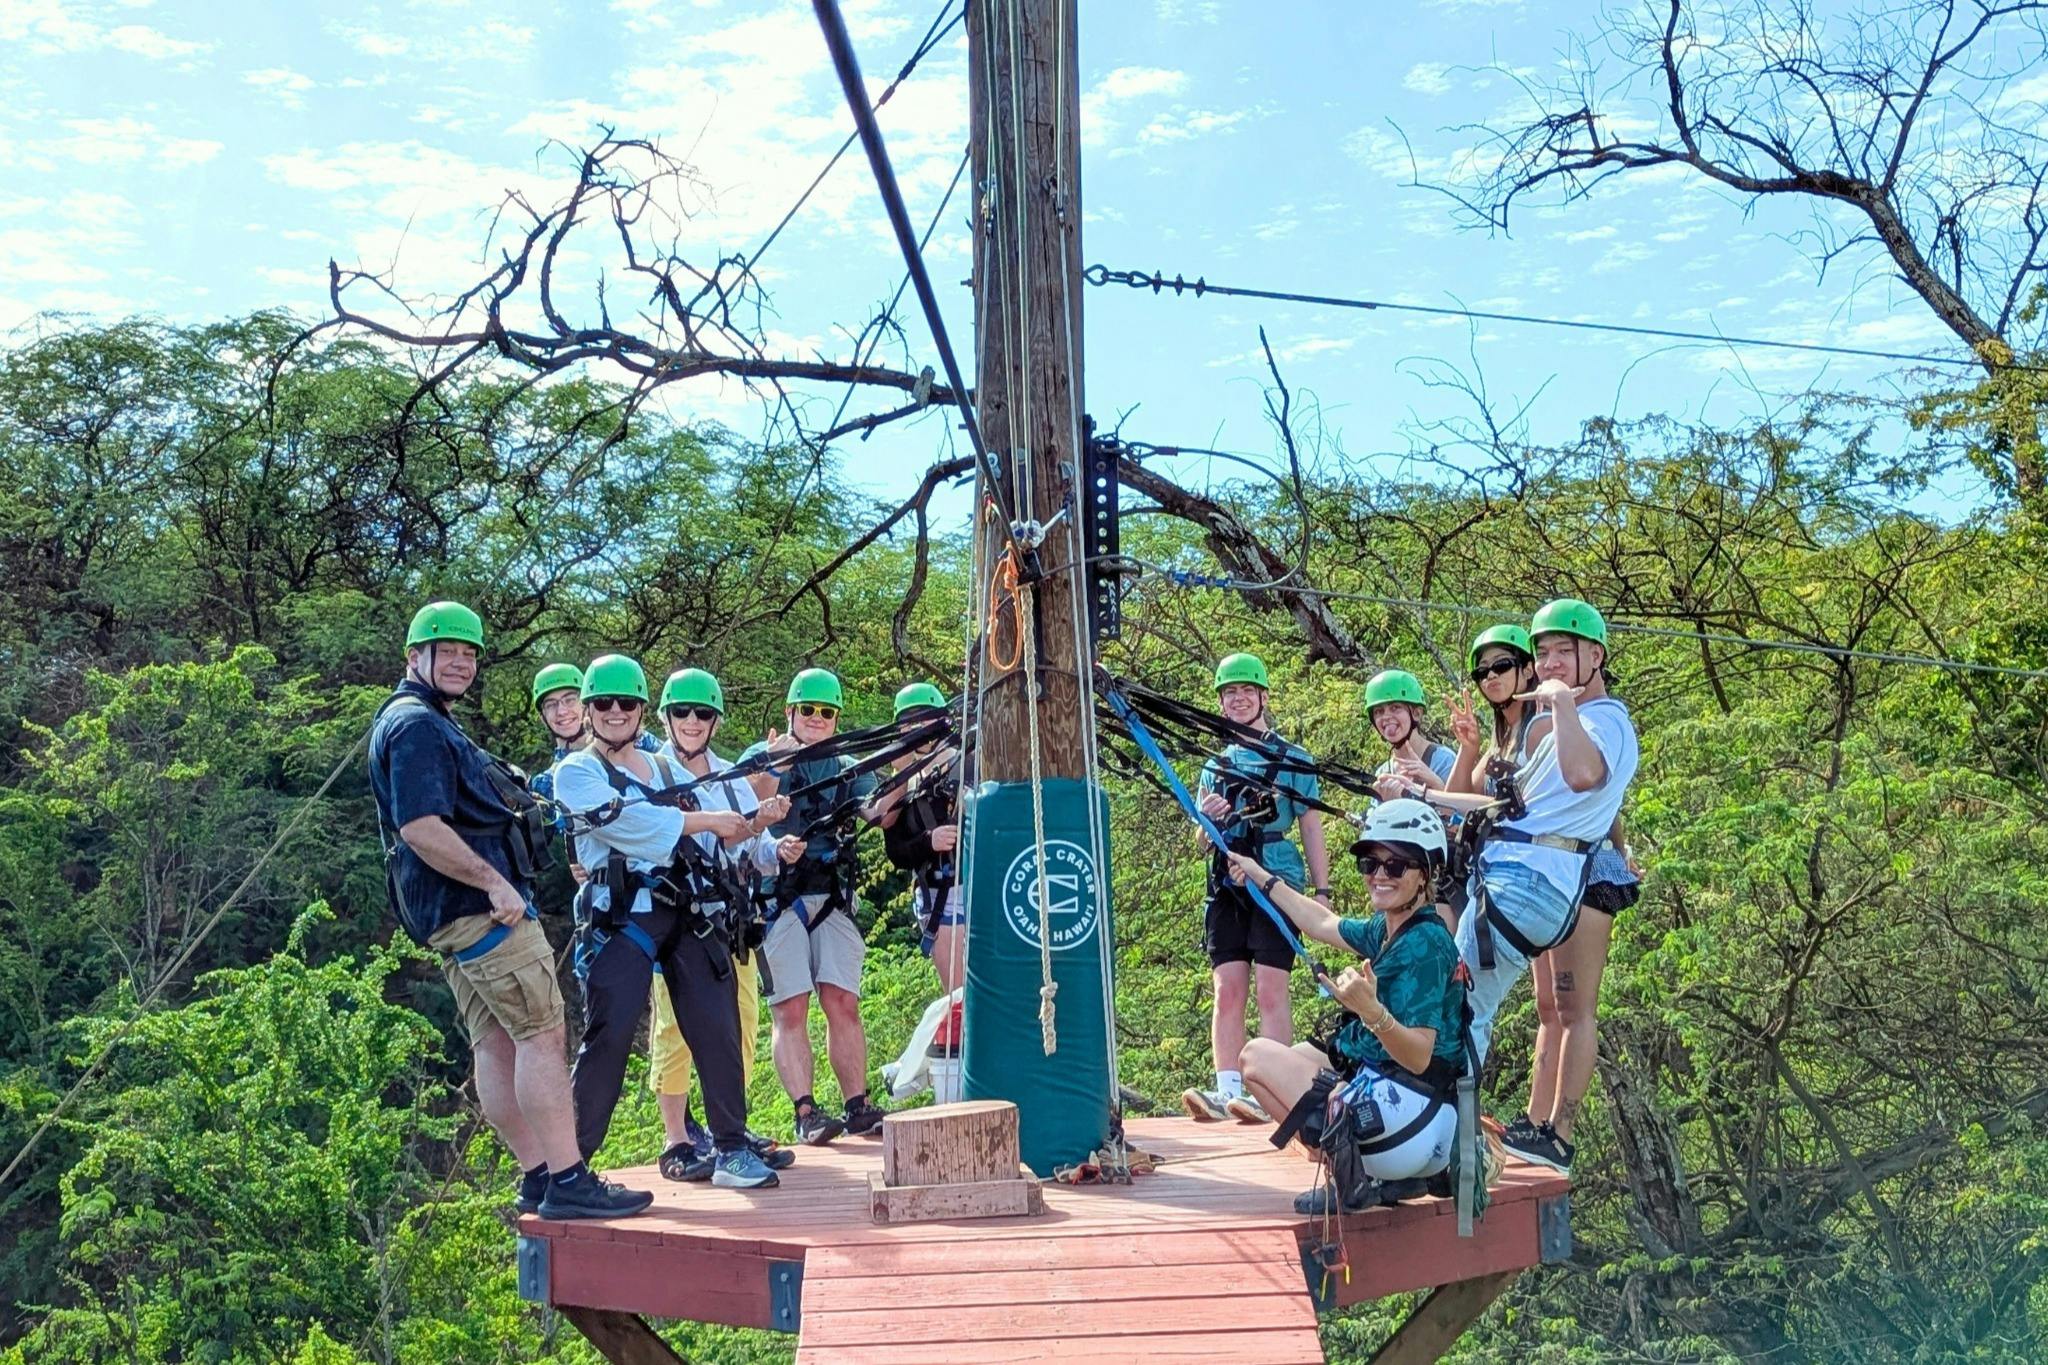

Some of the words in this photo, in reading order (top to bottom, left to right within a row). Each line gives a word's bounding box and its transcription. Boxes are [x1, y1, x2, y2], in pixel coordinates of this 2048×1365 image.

[1110, 624, 1119, 635] 2
[1056, 849, 1095, 894] CRATER
[1357, 1106, 1374, 1128] JBL
